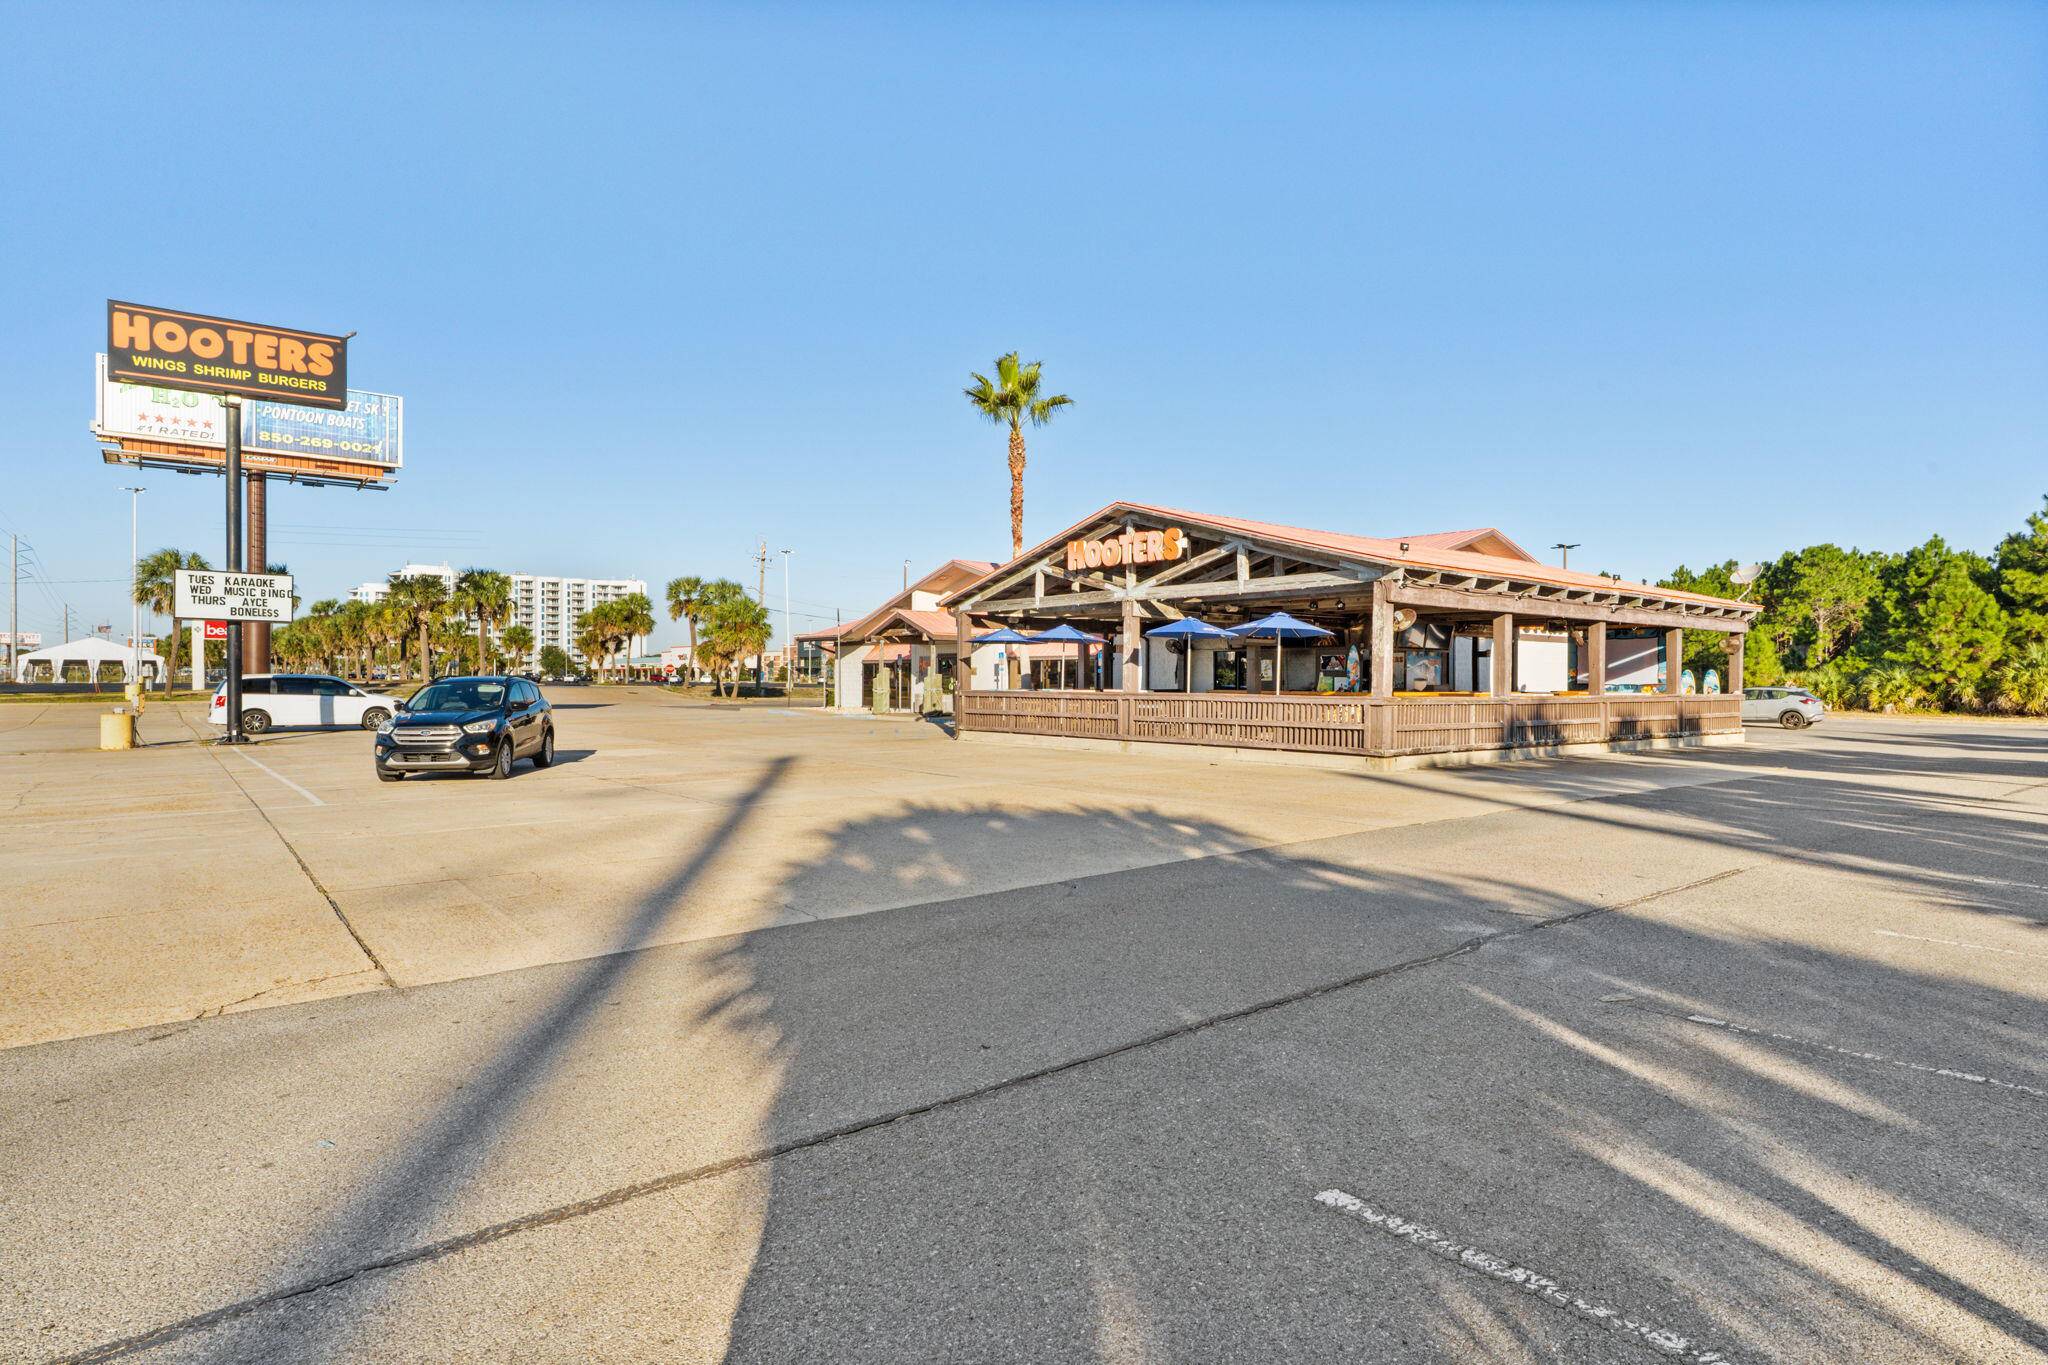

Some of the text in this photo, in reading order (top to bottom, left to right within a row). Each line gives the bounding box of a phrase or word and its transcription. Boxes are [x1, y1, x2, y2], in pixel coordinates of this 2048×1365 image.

[112, 311, 334, 376] HOOTERS
[132, 355, 327, 392] WINGS SHRIMP BURGERS
[262, 405, 366, 430] PONTOON BOATS
[159, 427, 216, 441] RATED!
[1067, 527, 1184, 571] HOOTERS
[188, 574, 275, 588] TUES KARAOKE
[190, 585, 293, 599] WED MUSIC BINGO
[191, 595, 268, 607] THURS AYCE
[230, 606, 279, 617] BONELESS
[206, 624, 228, 636] be
